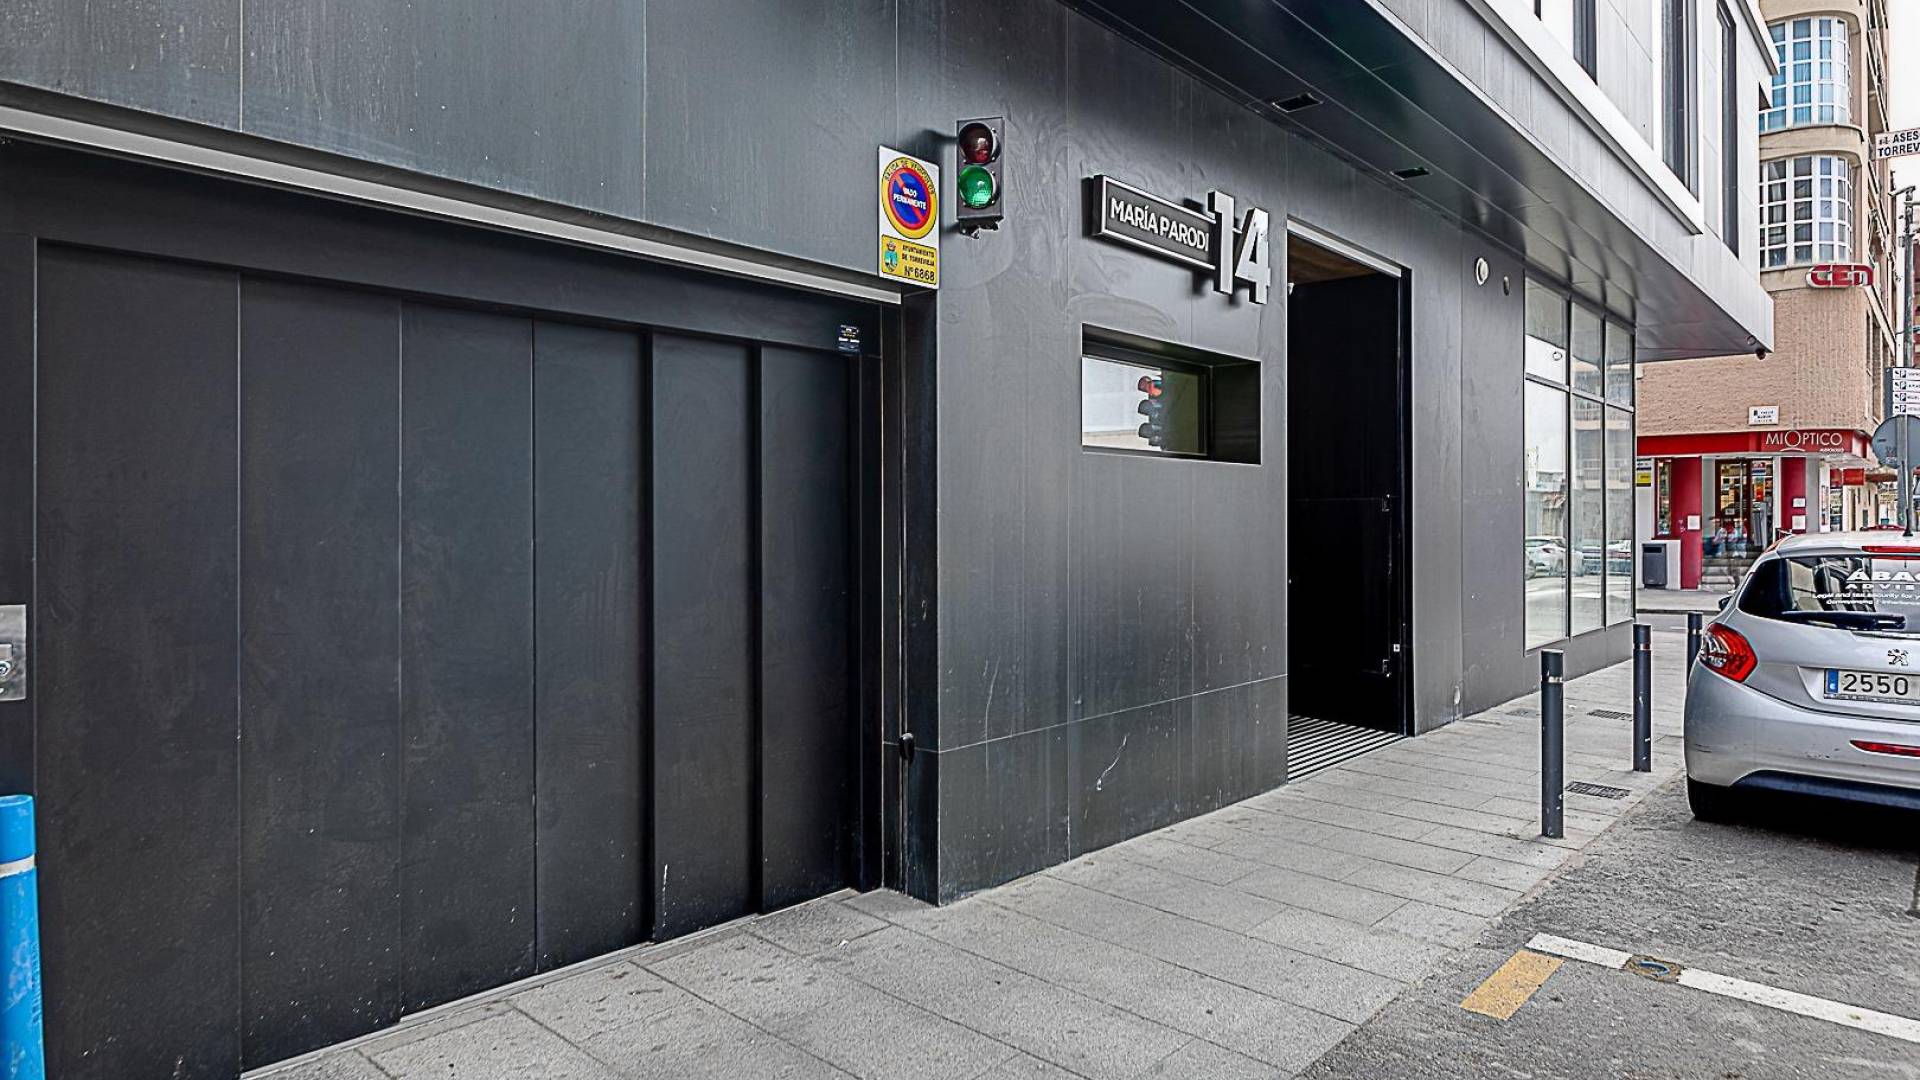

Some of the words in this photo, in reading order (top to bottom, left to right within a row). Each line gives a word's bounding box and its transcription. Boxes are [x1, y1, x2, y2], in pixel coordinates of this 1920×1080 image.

[903, 187, 917, 198] VADO
[893, 193, 927, 210] PERMANENTE
[1110, 197, 1158, 236] MARÍA
[1159, 216, 1209, 252] PARODI
[902, 244, 935, 258] AYUNTAMIENTO
[1211, 190, 1271, 304] 14
[901, 252, 908, 261] DE
[909, 255, 935, 267] TORREVIEJA
[1846, 568, 1920, 581] ÁBA
[1843, 673, 1909, 696] 2550
